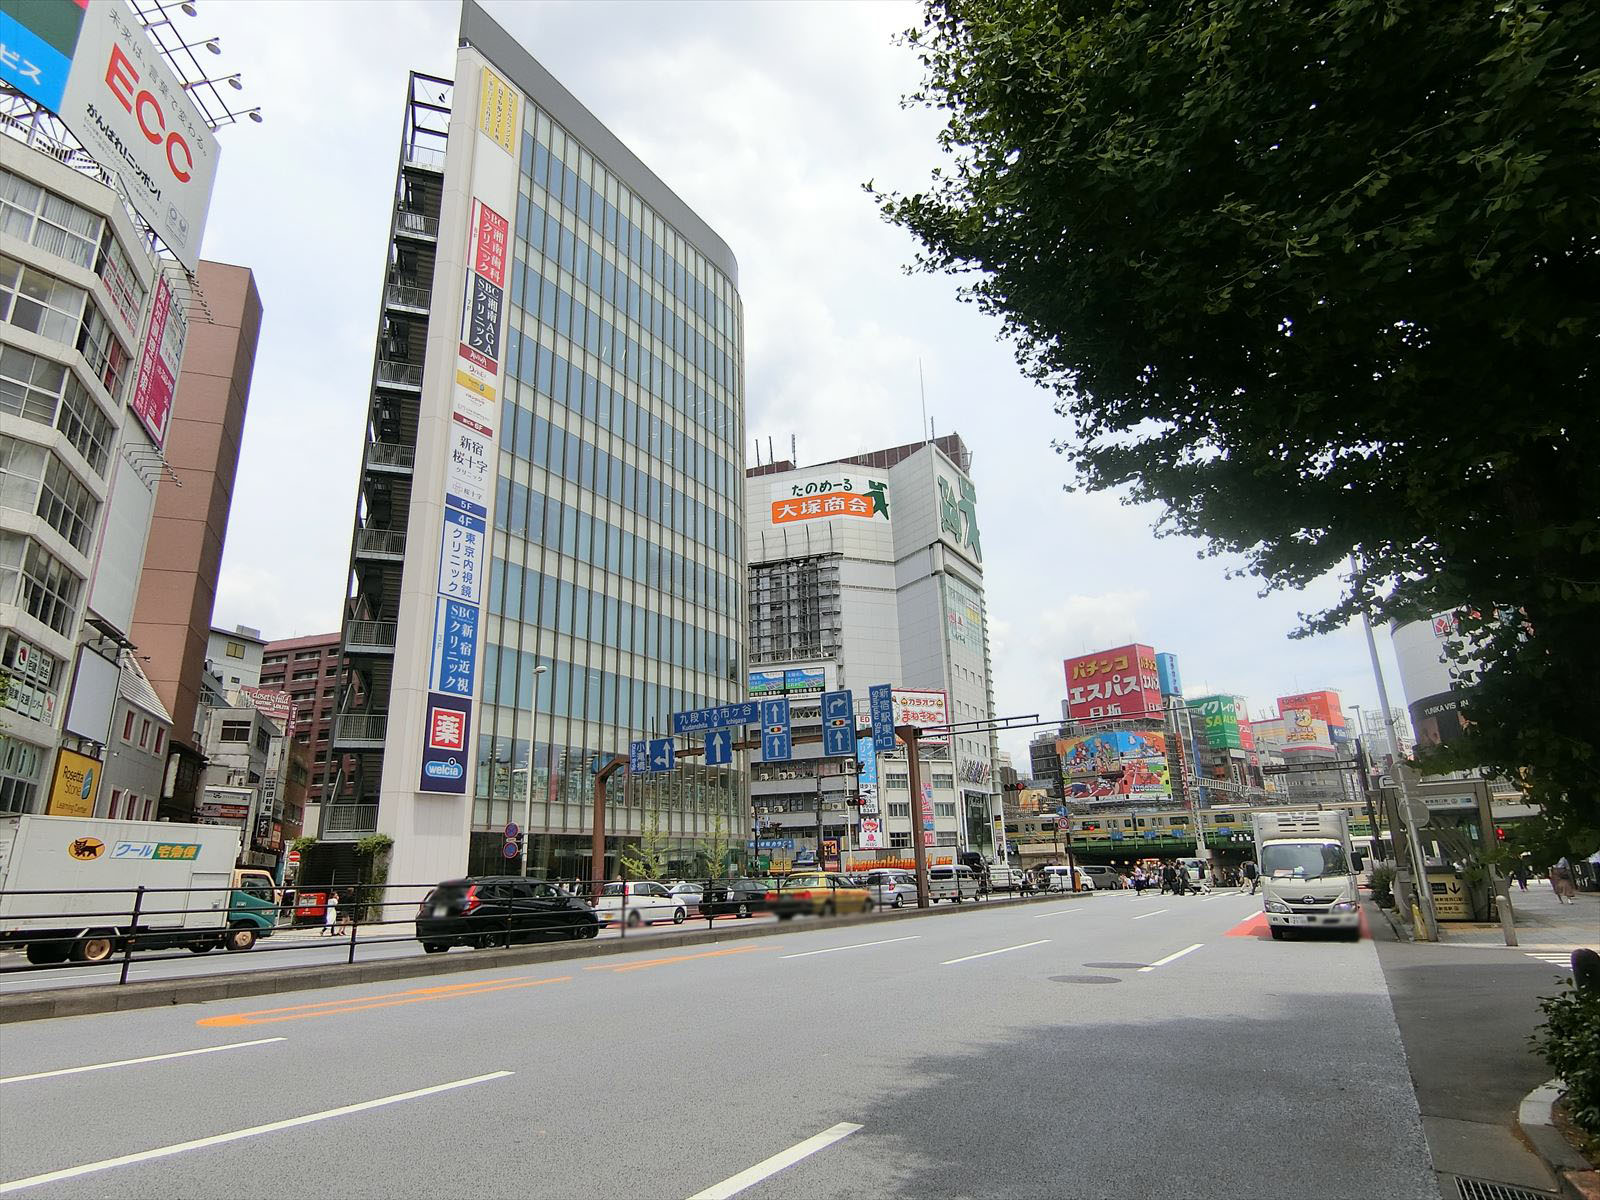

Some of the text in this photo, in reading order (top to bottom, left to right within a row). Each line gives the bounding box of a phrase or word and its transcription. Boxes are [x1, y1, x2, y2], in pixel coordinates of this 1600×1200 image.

[105, 43, 194, 183] ECC
[484, 208, 504, 231] SBC
[479, 223, 493, 272] クリニック
[490, 228, 504, 283] 湘南歯科
[478, 278, 500, 299] SBC
[473, 292, 486, 346] クリニック
[484, 298, 499, 356] 湘南AGA
[460, 435, 484, 456] 新宿
[452, 449, 488, 474] 桜十字
[456, 467, 483, 482] クリニック
[791, 478, 853, 496] たのめーる
[461, 500, 473, 511] 5F
[777, 497, 868, 519] 大塚商会
[458, 514, 472, 526] 4F
[448, 528, 462, 592] クリニック
[461, 532, 476, 598] 東京内視鏡
[451, 605, 475, 620] SBC
[444, 621, 459, 688] クリニック
[457, 623, 473, 692] 新宿近視
[1073, 655, 1129, 680] パチンコ
[1069, 675, 1141, 705] エスパス
[871, 690, 879, 720] Shinjuku
[909, 699, 935, 707] カラオケ
[1424, 705, 1445, 715] YUNIKA
[679, 711, 710, 724] 九段下
[682, 717, 747, 731] Kudanshita Ichigaya
[878, 688, 893, 747] 新宿駅東口
[902, 709, 944, 723] まねきねこ
[435, 715, 459, 744] 薬
[63, 765, 84, 783] Rosetta
[429, 760, 459, 777] welcia
[65, 781, 82, 797] Stone
[117, 843, 197, 858] クール 宅急便
